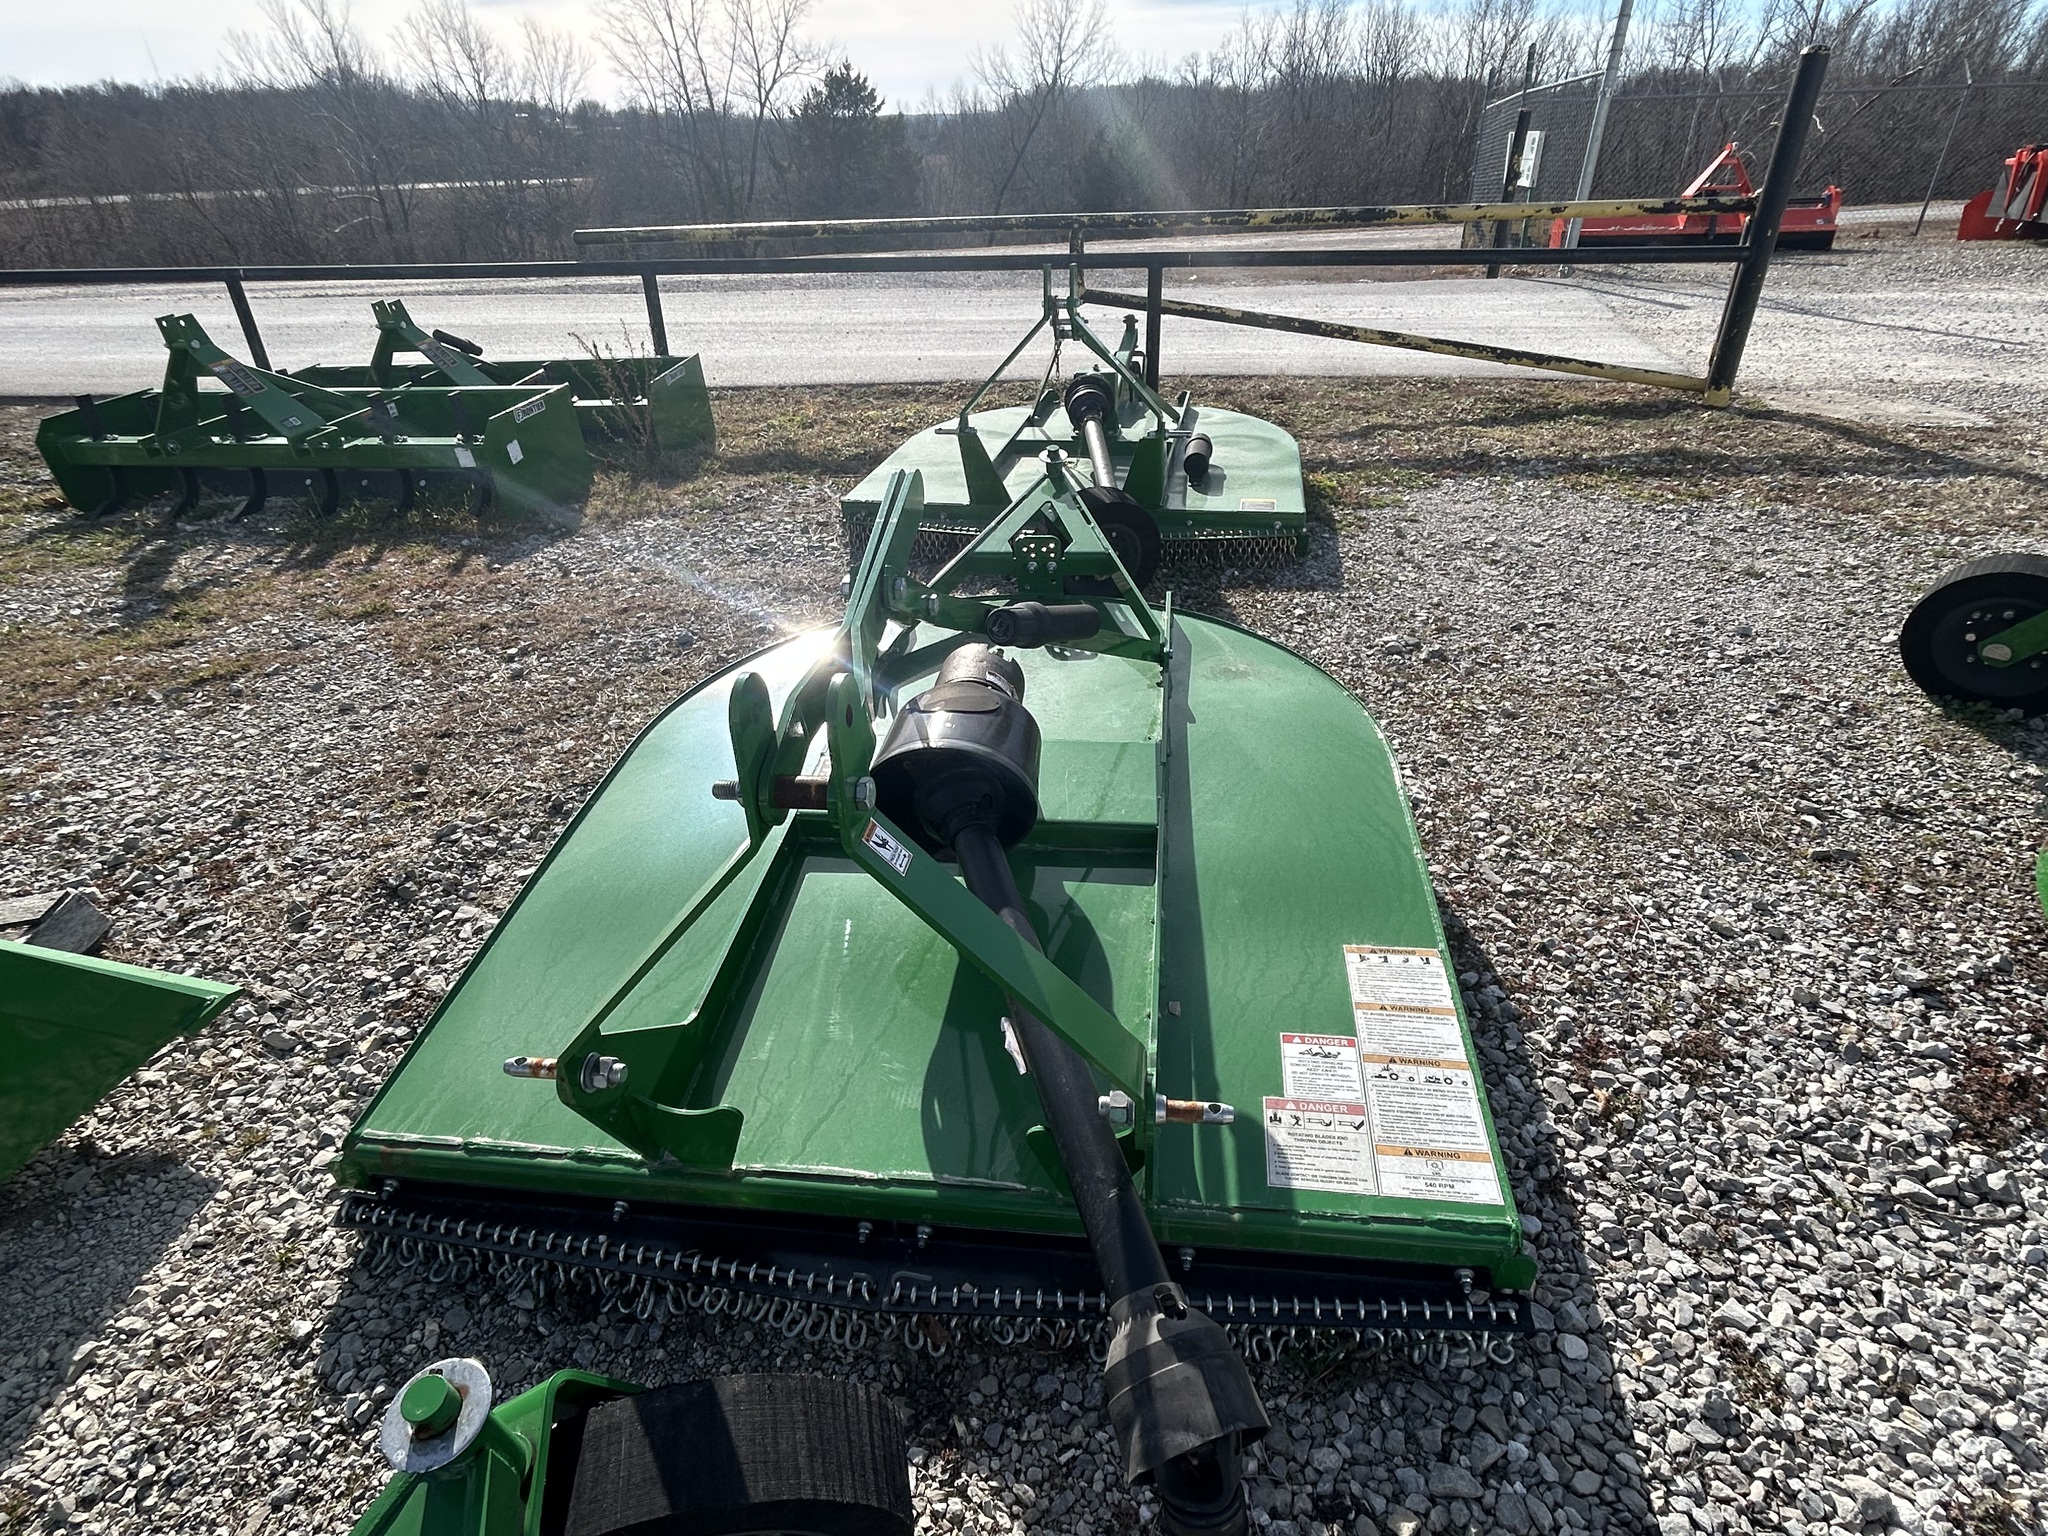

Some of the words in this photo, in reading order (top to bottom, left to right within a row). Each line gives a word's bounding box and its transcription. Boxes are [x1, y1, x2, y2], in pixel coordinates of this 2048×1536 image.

[1389, 1005, 1430, 1013] WARNING
[1305, 1035, 1349, 1046] DANGER
[1399, 1058, 1441, 1067] WARNING
[1299, 1102, 1348, 1113] DANGER
[1415, 1149, 1461, 1159] WARNING
